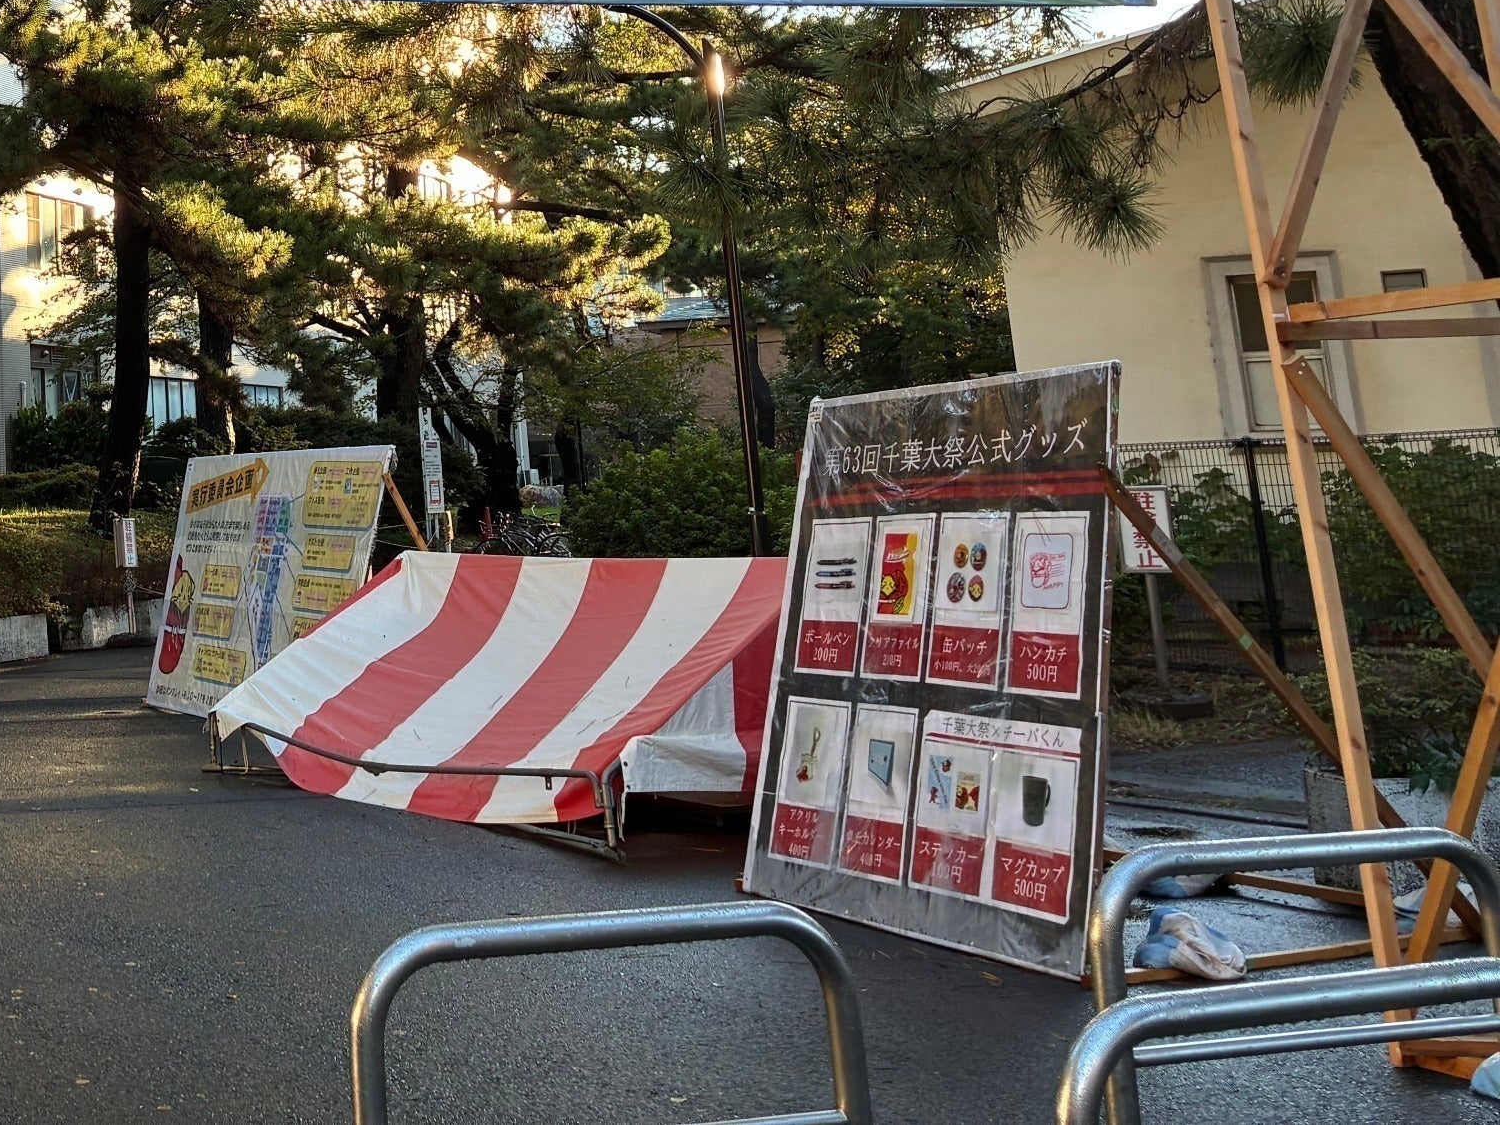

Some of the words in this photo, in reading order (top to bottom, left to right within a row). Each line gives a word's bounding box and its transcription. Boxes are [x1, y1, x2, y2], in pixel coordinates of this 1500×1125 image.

[824, 418, 1088, 476] 第63回千葉大祭公式グッズ
[191, 469, 255, 508] 実行委員会企画
[1130, 491, 1163, 568] 駐禁止
[804, 630, 851, 646] ボールペン
[813, 647, 838, 663] 200円
[1020, 644, 1068, 663] ハンカチ
[1026, 663, 1058, 682] 500円
[1001, 858, 1065, 883] マグカップ
[1014, 878, 1047, 902] 500円
